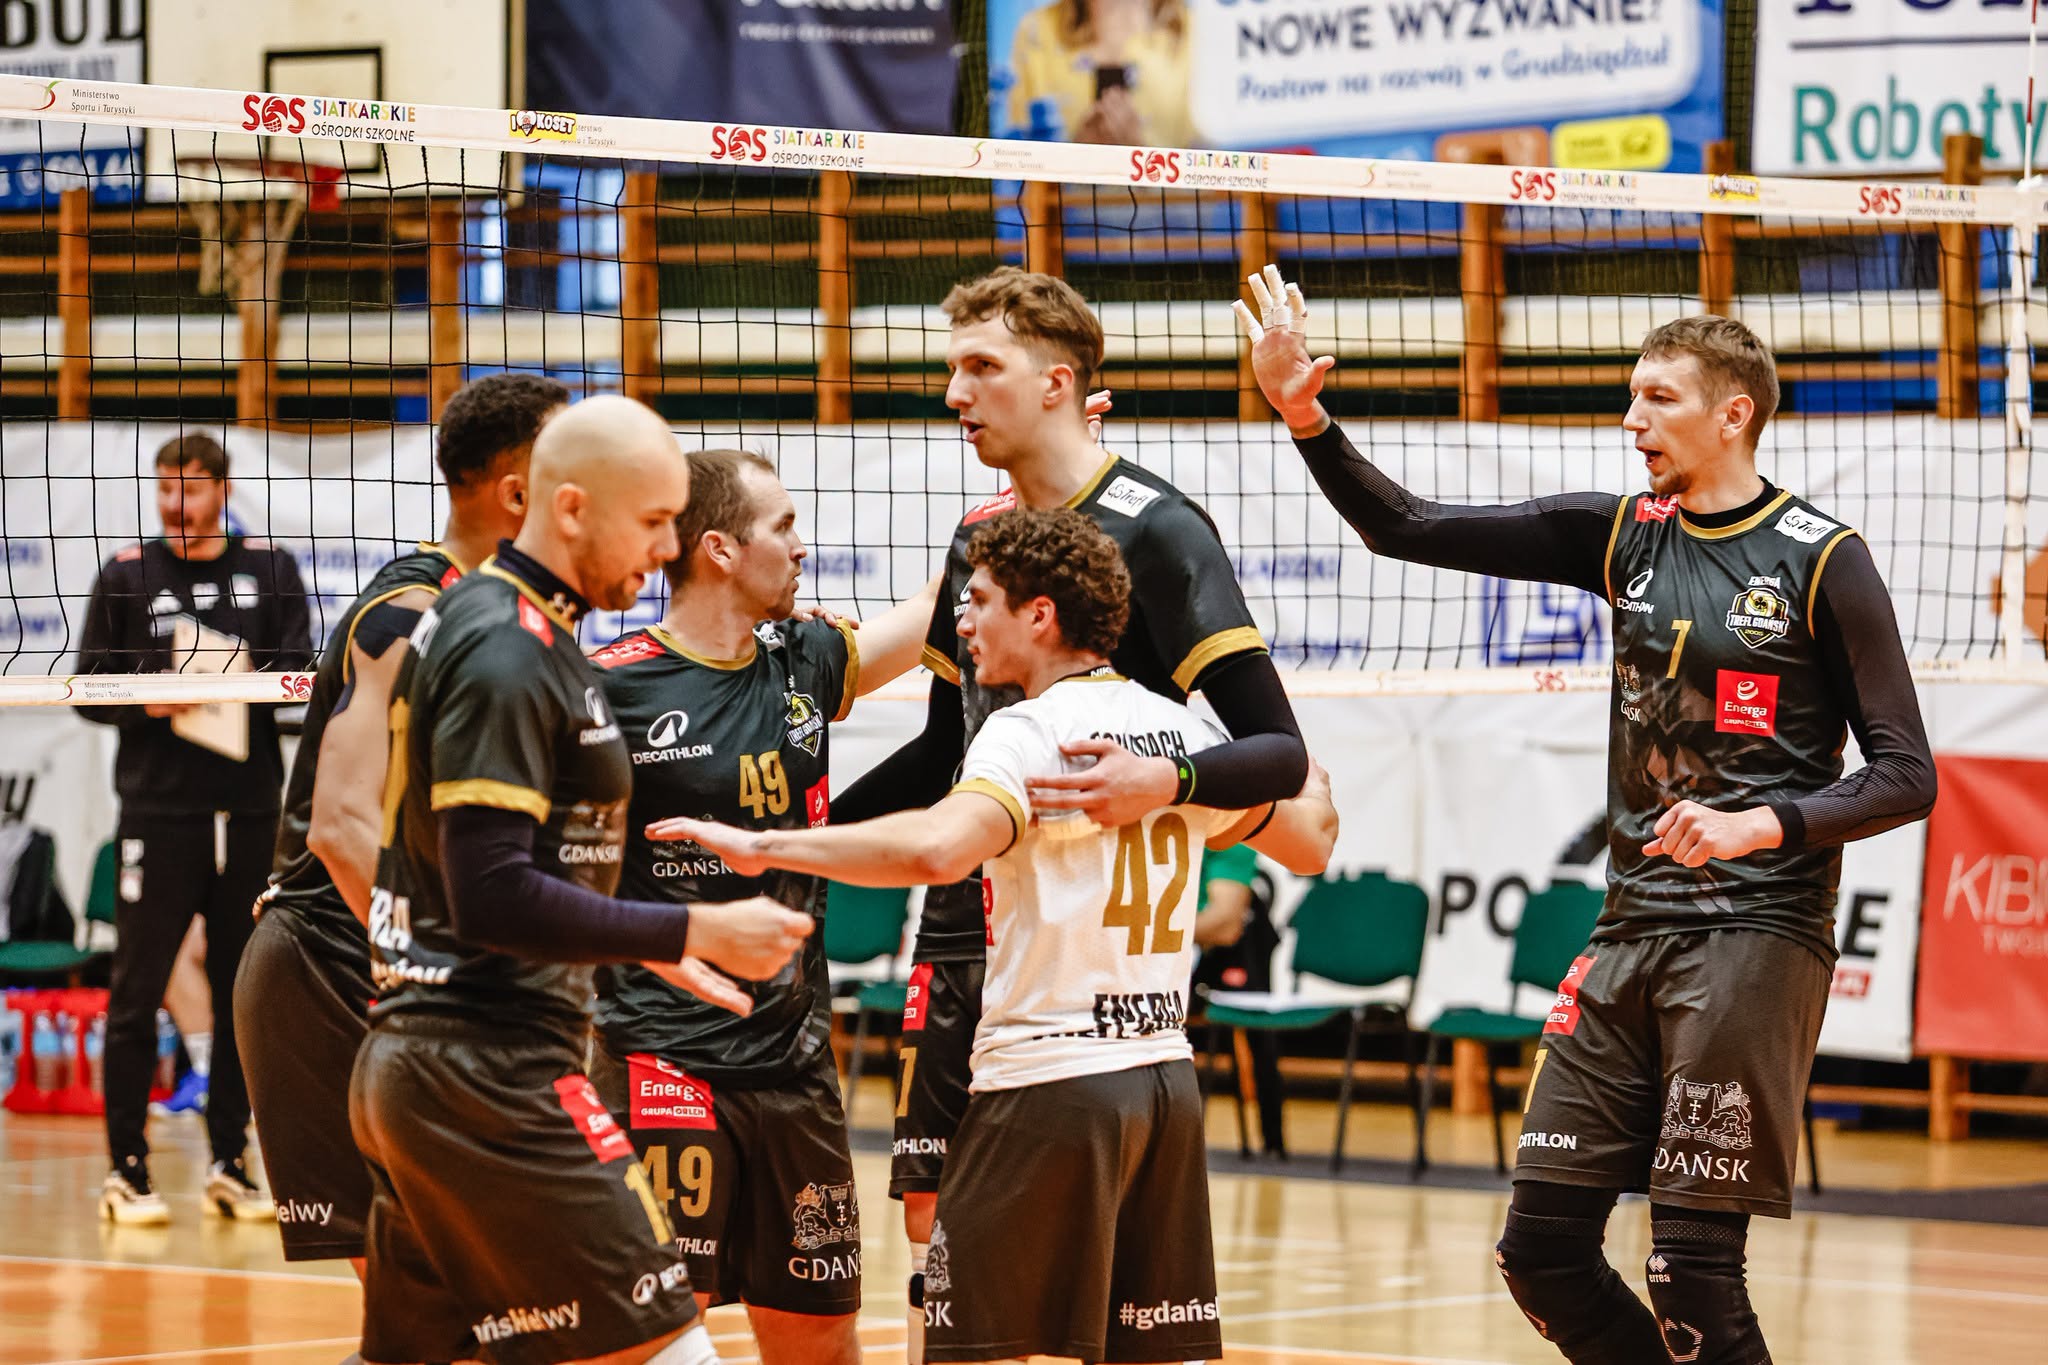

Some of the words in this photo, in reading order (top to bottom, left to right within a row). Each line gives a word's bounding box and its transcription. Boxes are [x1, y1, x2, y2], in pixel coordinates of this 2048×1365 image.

[1238, 6, 1372, 57] NOWE
[72, 89, 120, 101] Ministerstwo
[71, 102, 96, 112] Sportu
[103, 104, 136, 116] Turystyki
[242, 94, 306, 134] SOS
[313, 99, 416, 122] SIATKARSKIE
[1793, 74, 2048, 165] Roboty
[311, 121, 363, 139] OŚRODKI
[366, 127, 416, 142] SZKOLNE
[710, 125, 767, 162] SOS
[773, 129, 865, 149] SIATKARSKIE
[771, 151, 817, 166] OŚRODKI
[820, 155, 864, 168] SZKOLNE
[1129, 150, 1180, 183] SOS
[1185, 152, 1270, 171] SIATKARSKIE
[1510, 170, 1556, 201] SOS
[1859, 186, 1902, 215] SOS
[1120, 489, 1148, 508] Trefl
[1798, 520, 1828, 537] Trefl
[1666, 619, 1693, 680] 7
[281, 675, 316, 701] SO
[1724, 701, 1768, 718] Energa
[632, 743, 714, 766] DECATHLON
[739, 750, 790, 819] 49
[1102, 812, 1190, 956] 42
[641, 1107, 672, 1116] GRUPA
[674, 1106, 706, 1117] ORLEN
[1652, 1147, 1750, 1183] DAŃSK
[788, 1248, 861, 1281] GDAŃ
